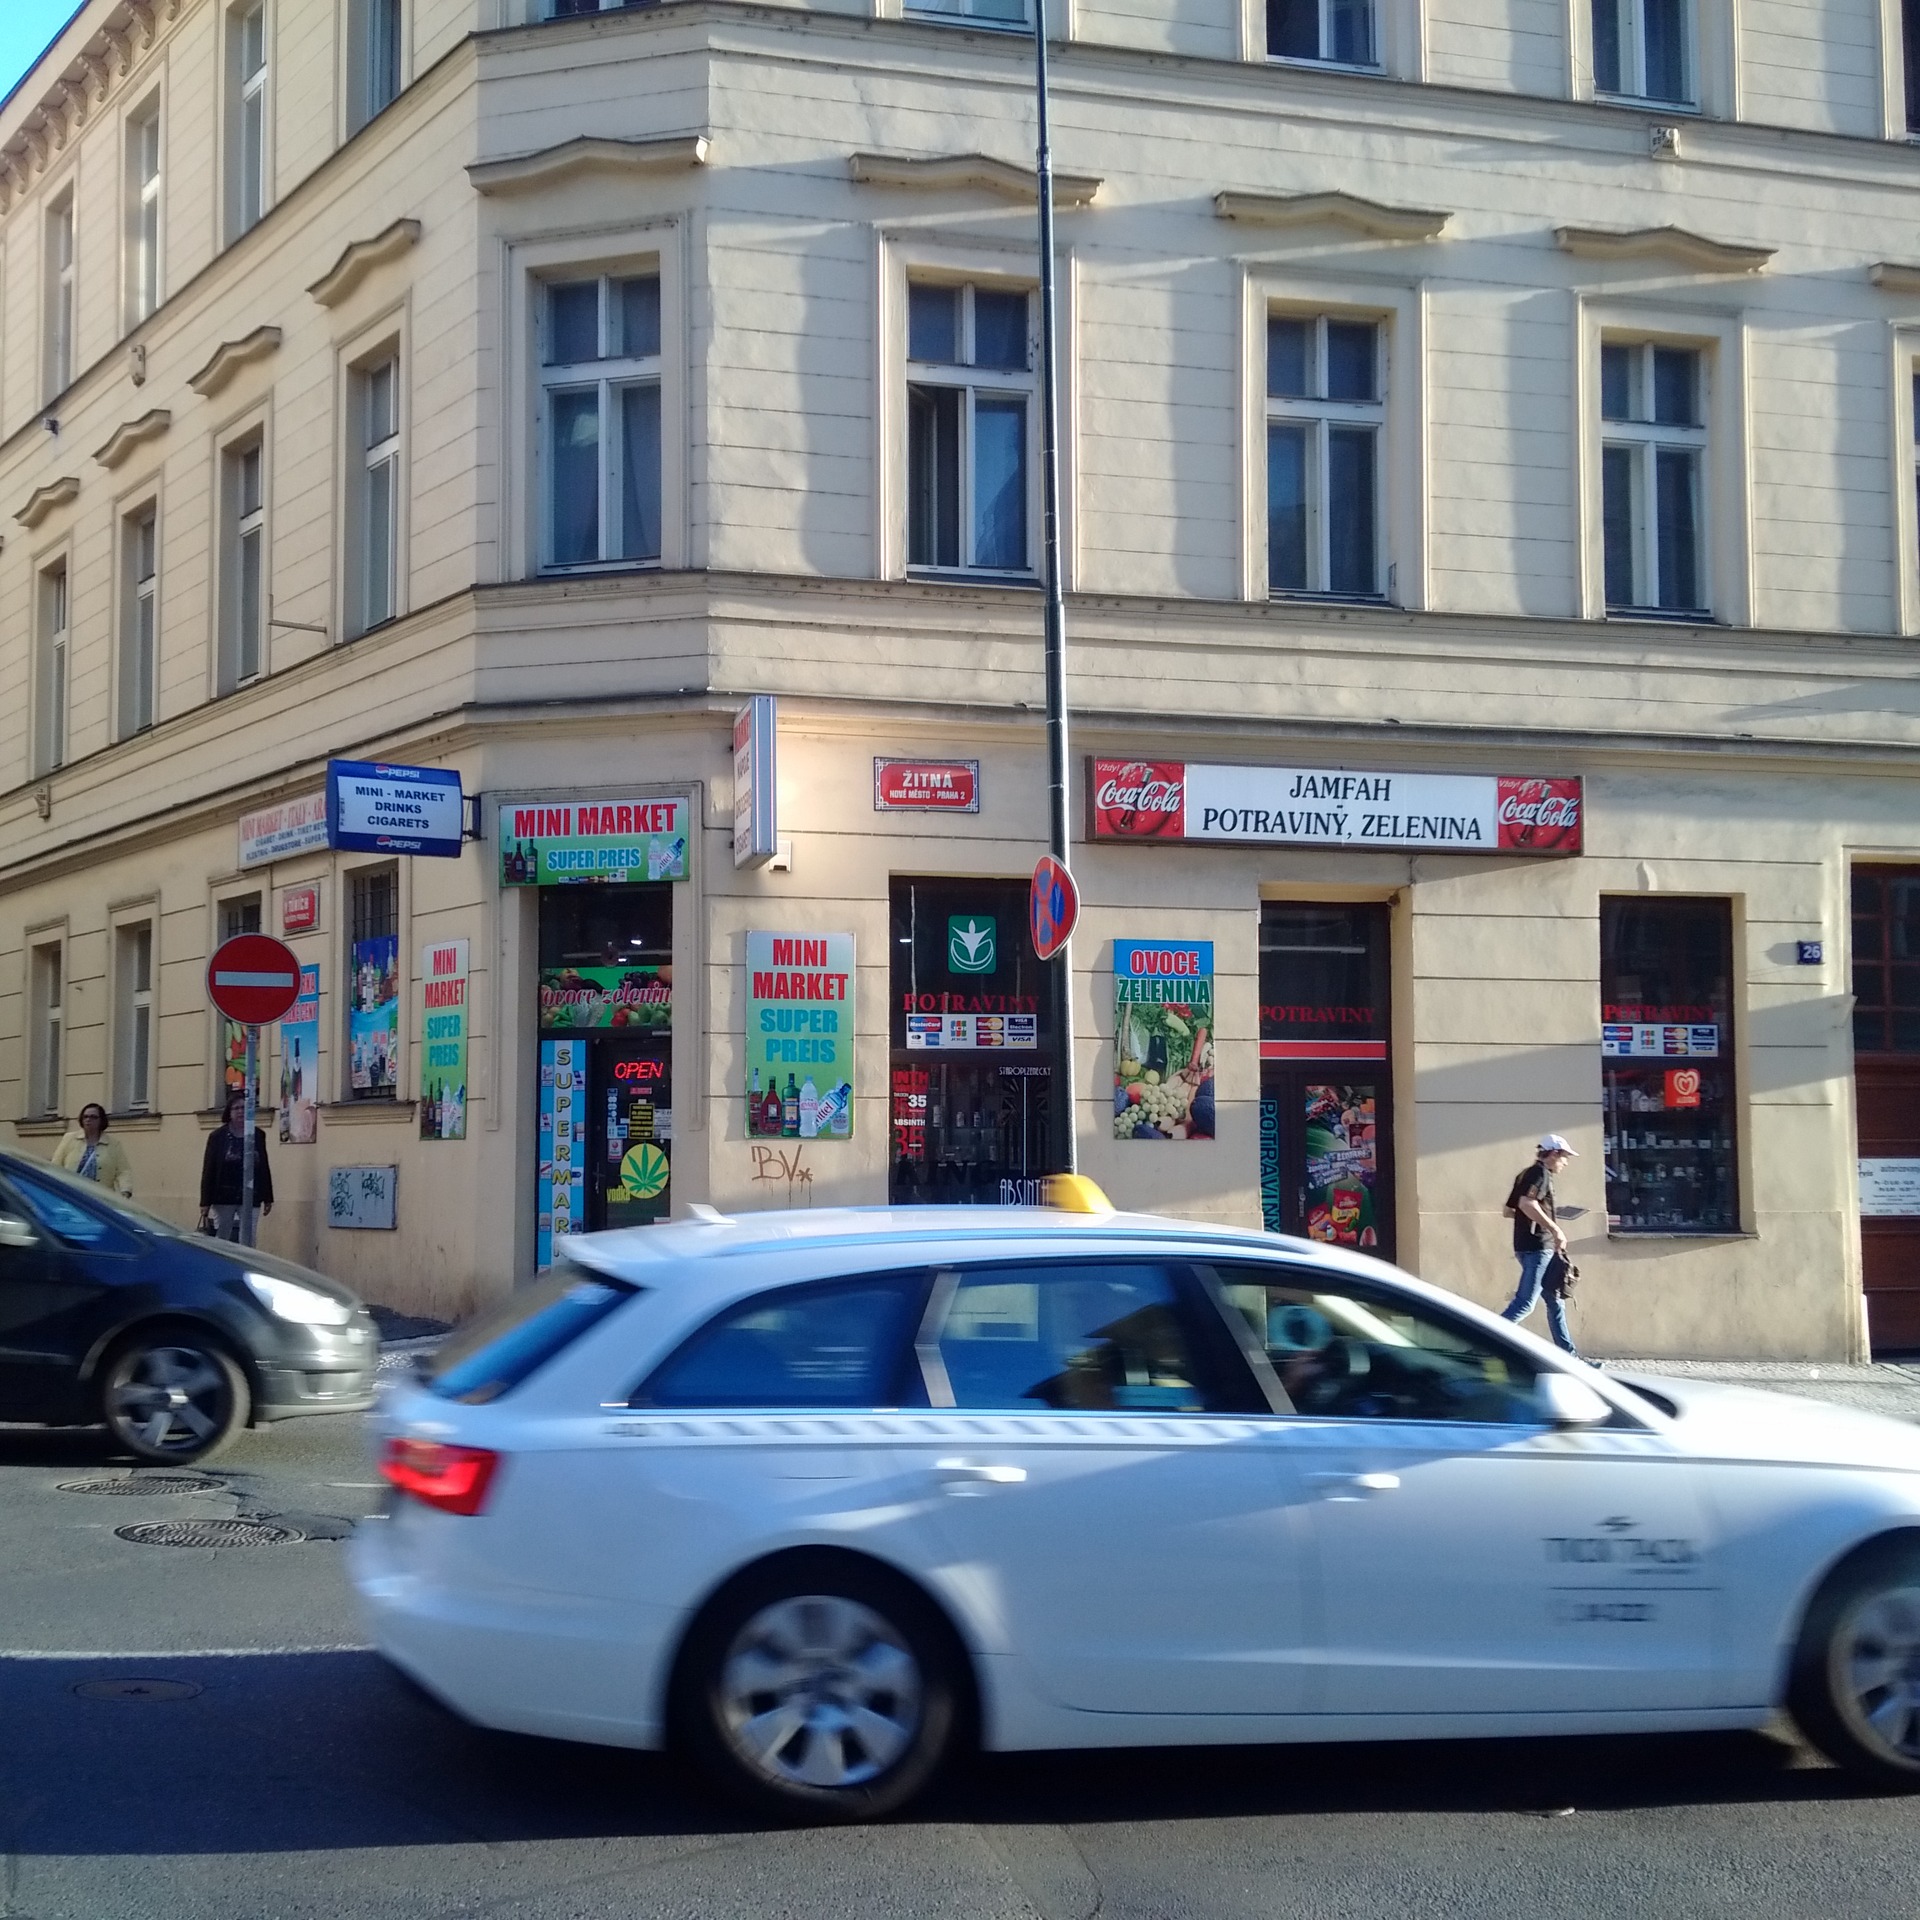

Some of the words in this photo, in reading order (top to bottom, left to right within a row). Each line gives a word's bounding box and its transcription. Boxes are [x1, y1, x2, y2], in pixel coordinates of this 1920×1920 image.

[388, 768, 420, 779] PEPSI
[902, 770, 953, 788] ŽITNÁ
[355, 786, 383, 798] MINI
[394, 789, 446, 802] MARKET
[889, 788, 907, 799] NOVÉ
[908, 788, 931, 799] MĚSTO
[936, 790, 959, 800] PRAHA
[960, 791, 966, 800] 2
[1097, 779, 1183, 812] Coca-Cola
[1289, 775, 1392, 801] JAMFAH
[375, 801, 422, 814] DRINKS
[514, 808, 571, 838] MINI
[577, 803, 678, 836] MARKET
[1499, 795, 1579, 827] Coca-Cola
[367, 815, 430, 829] CIGARETS
[1202, 808, 1353, 839] POTRAVINY,
[1360, 814, 1482, 840] ZELENINA
[388, 840, 422, 849] PEPSI
[547, 849, 595, 870] SUPER
[597, 847, 641, 869] PREIS
[433, 947, 457, 977] MINI
[772, 938, 828, 968] MINI
[1131, 949, 1199, 976] OVOCE
[1803, 945, 1821, 959] 26
[425, 978, 466, 1009] MARKET
[542, 988, 597, 1006] ovoce
[601, 980, 672, 1005] zelenin
[752, 971, 849, 1001] MARKET
[1117, 978, 1211, 1004] ZELENINA
[903, 993, 1039, 1012] POTRAVINY
[1258, 1005, 1376, 1023] POTRAVINY
[427, 1014, 461, 1040] SUPER
[760, 1008, 839, 1033] SUPER
[429, 1042, 460, 1068] PREIS
[765, 1038, 836, 1064] PREIS
[614, 1061, 664, 1079] OPEN
[908, 1094, 927, 1108] 35
[894, 1118, 926, 1127] ABSINTH
[999, 1178, 1050, 1207] ABSINTH
